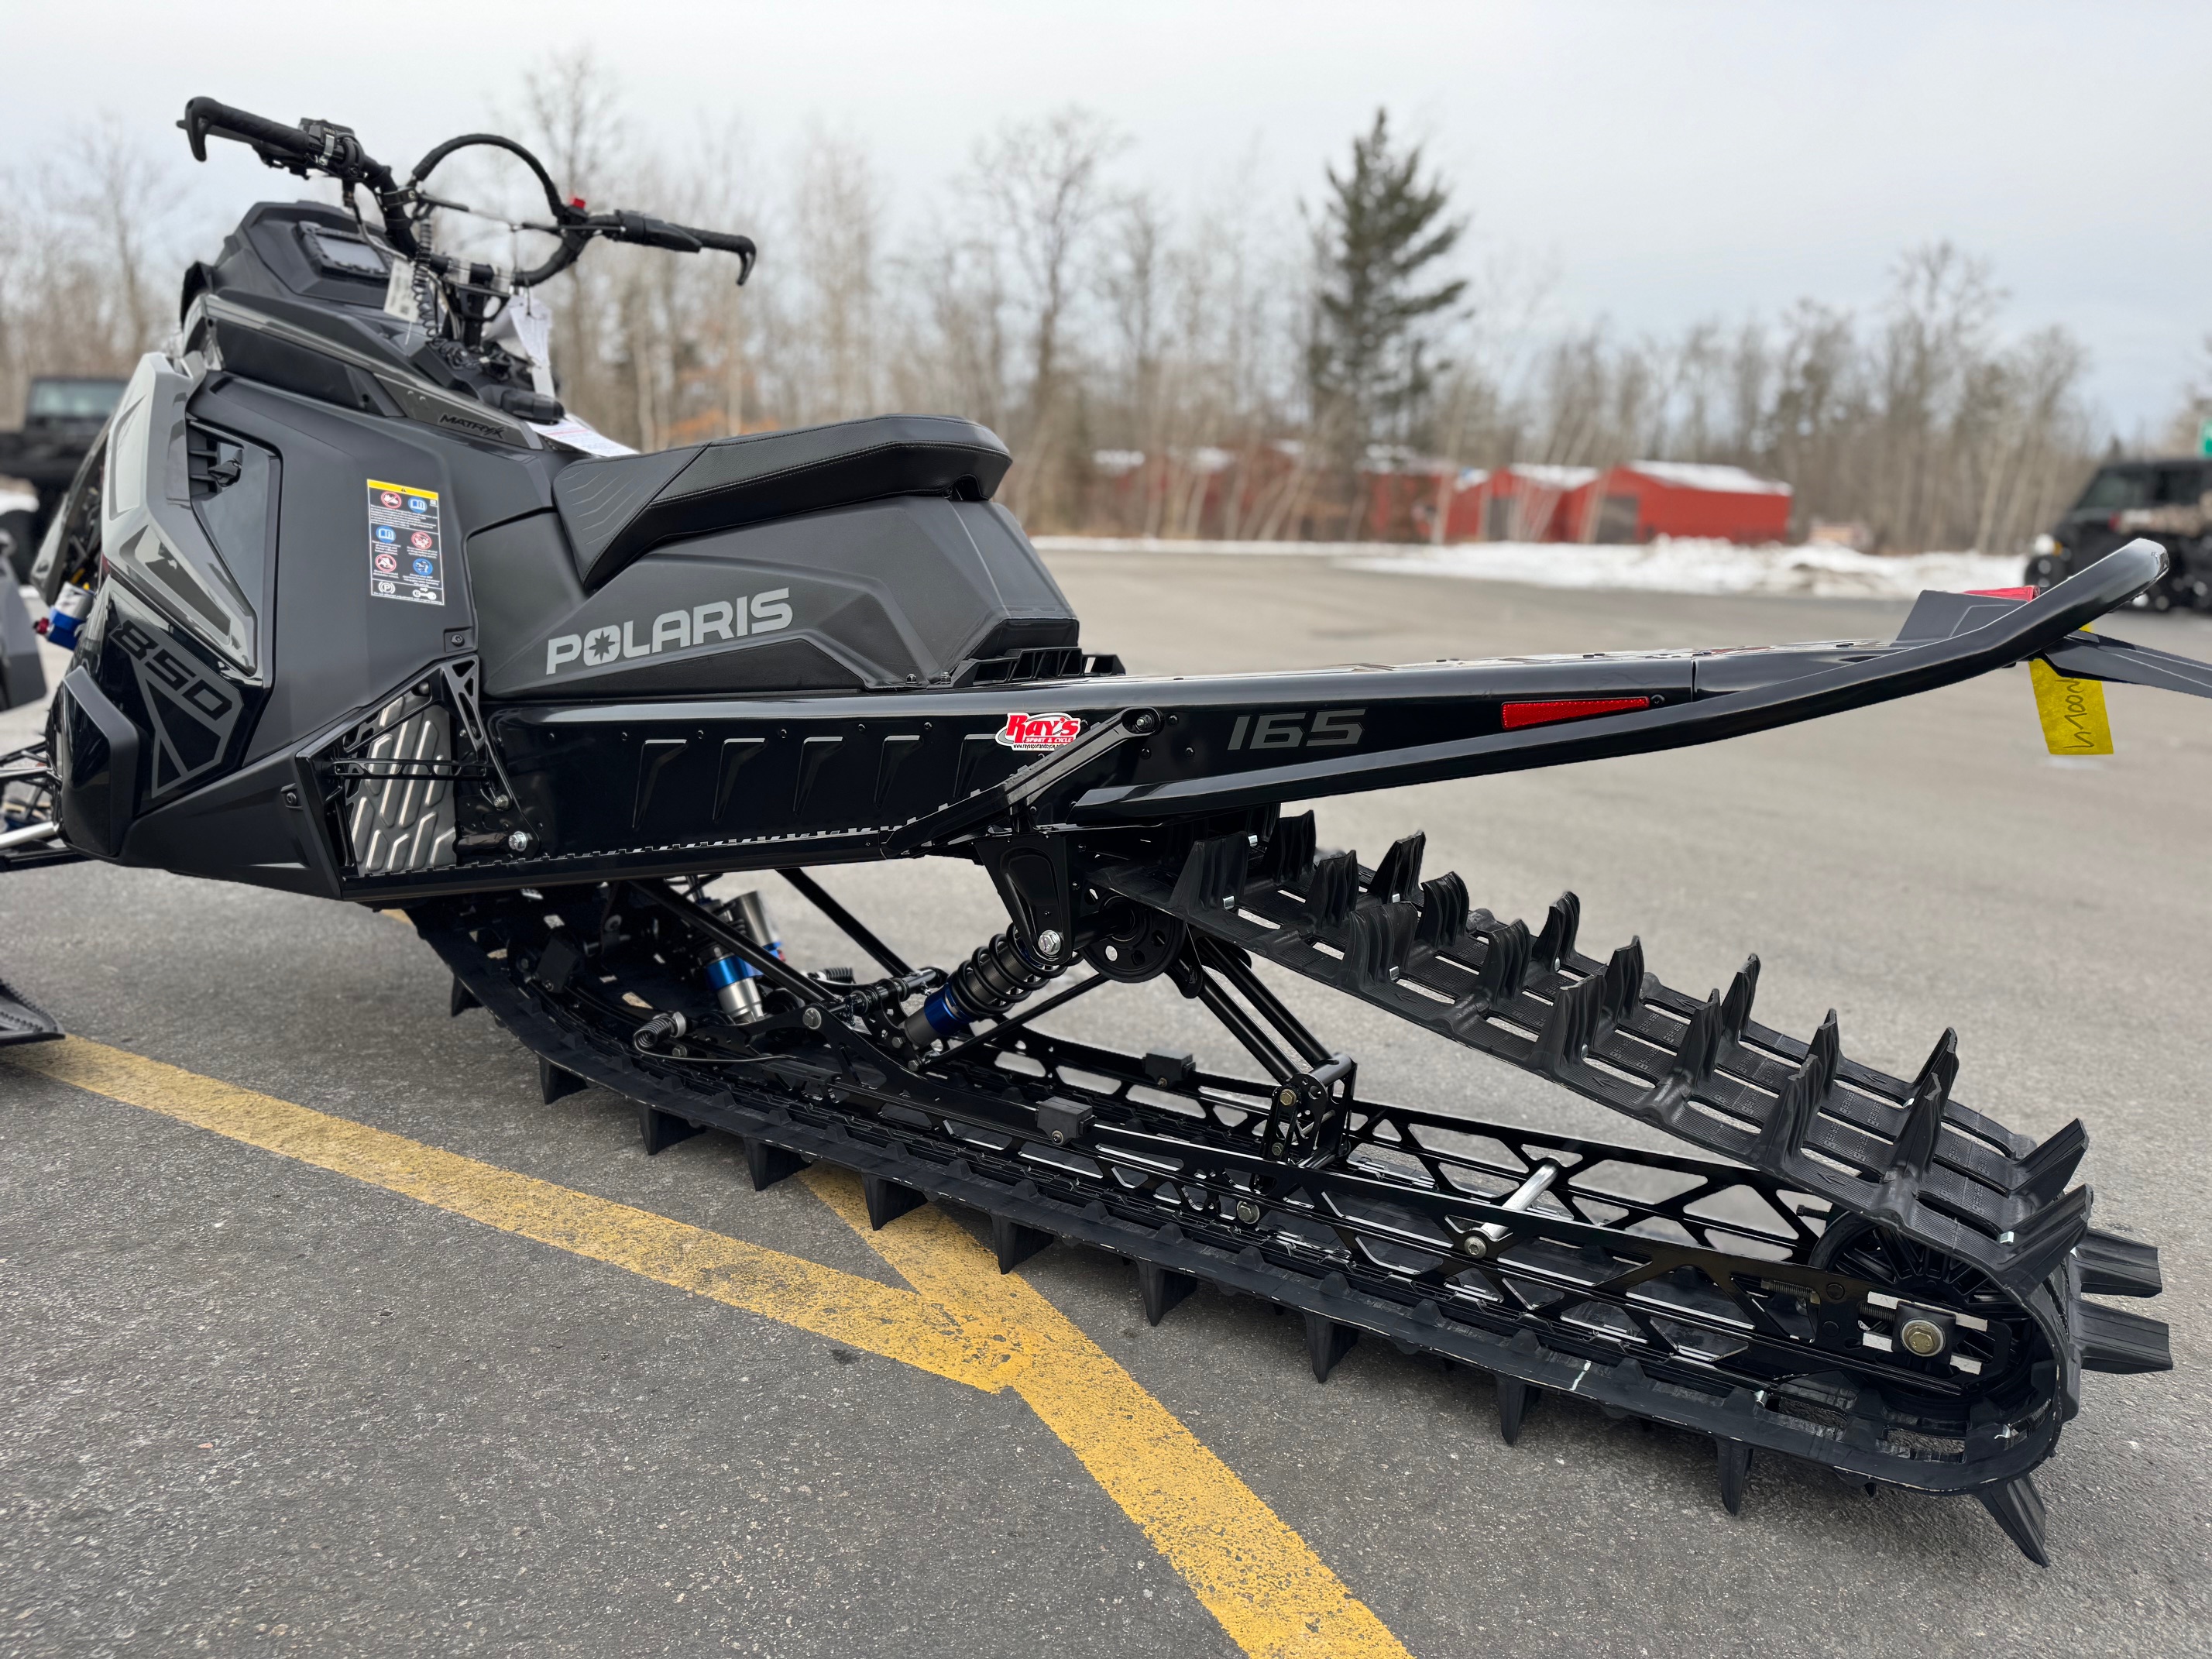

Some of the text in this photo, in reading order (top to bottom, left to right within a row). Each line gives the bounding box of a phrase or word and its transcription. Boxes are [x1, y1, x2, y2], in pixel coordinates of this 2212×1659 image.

[440, 414, 505, 439] MATRYX
[546, 587, 793, 675] POLARIS
[111, 620, 232, 721] 850
[1228, 708, 1366, 750] 165
